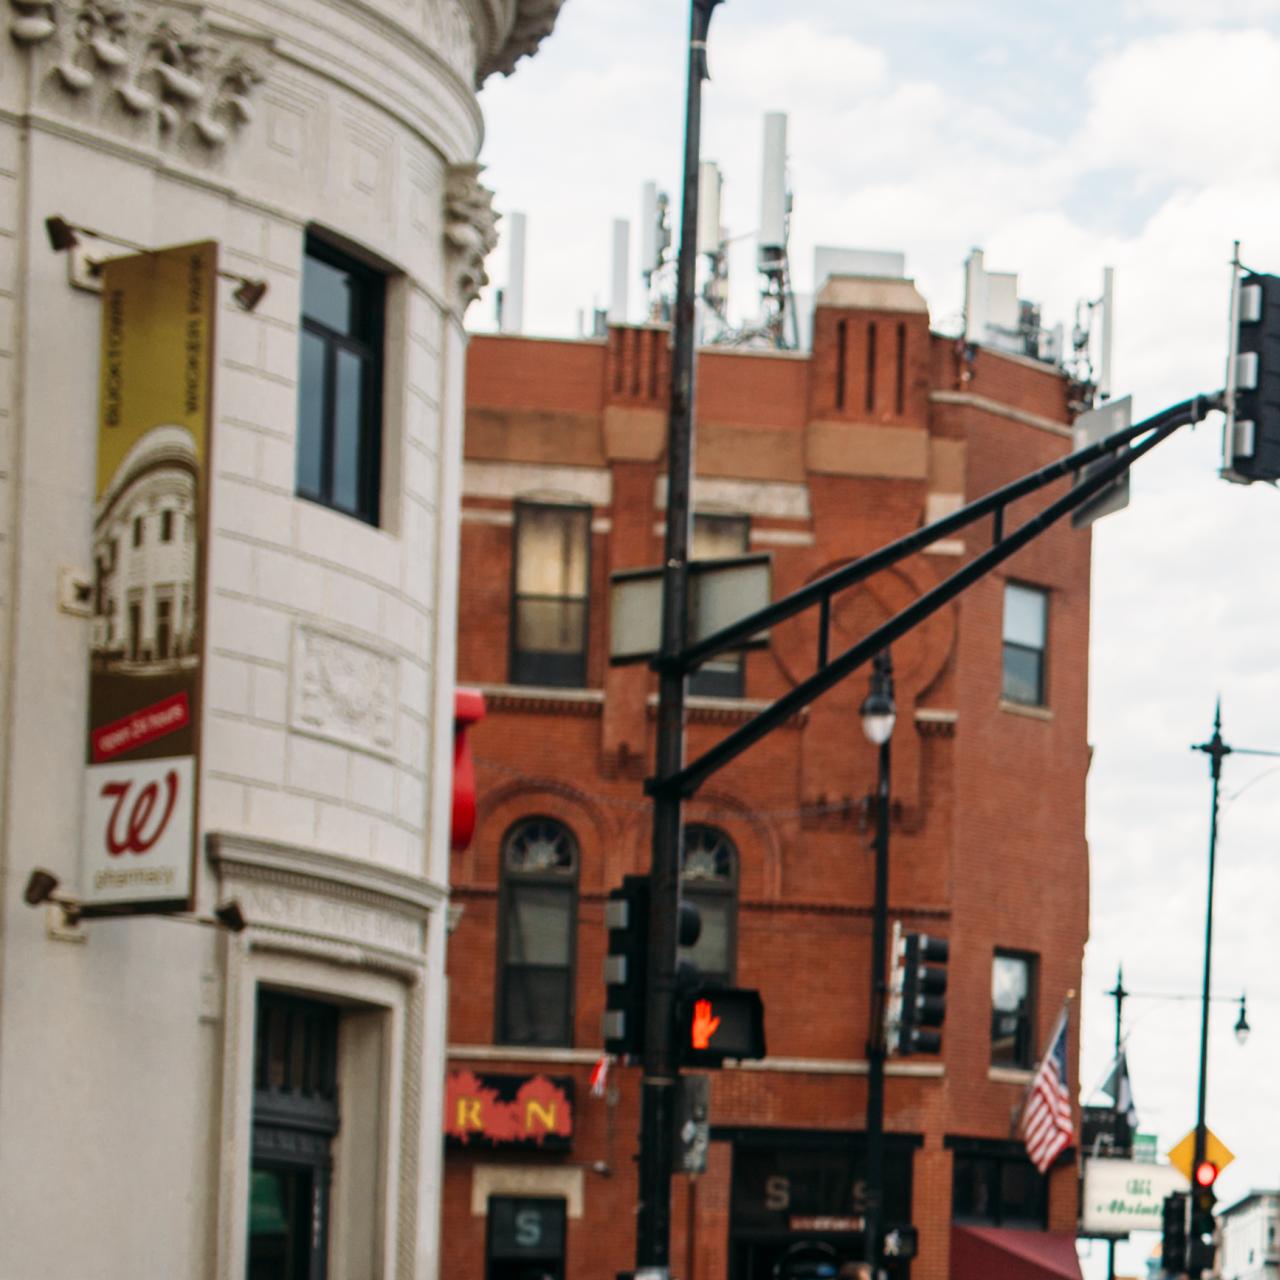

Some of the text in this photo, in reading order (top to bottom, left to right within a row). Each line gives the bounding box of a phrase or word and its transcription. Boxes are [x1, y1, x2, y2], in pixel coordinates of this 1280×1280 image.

[149, 703, 184, 730] hours
[101, 768, 179, 860] W
[96, 868, 176, 889] pharmacy
